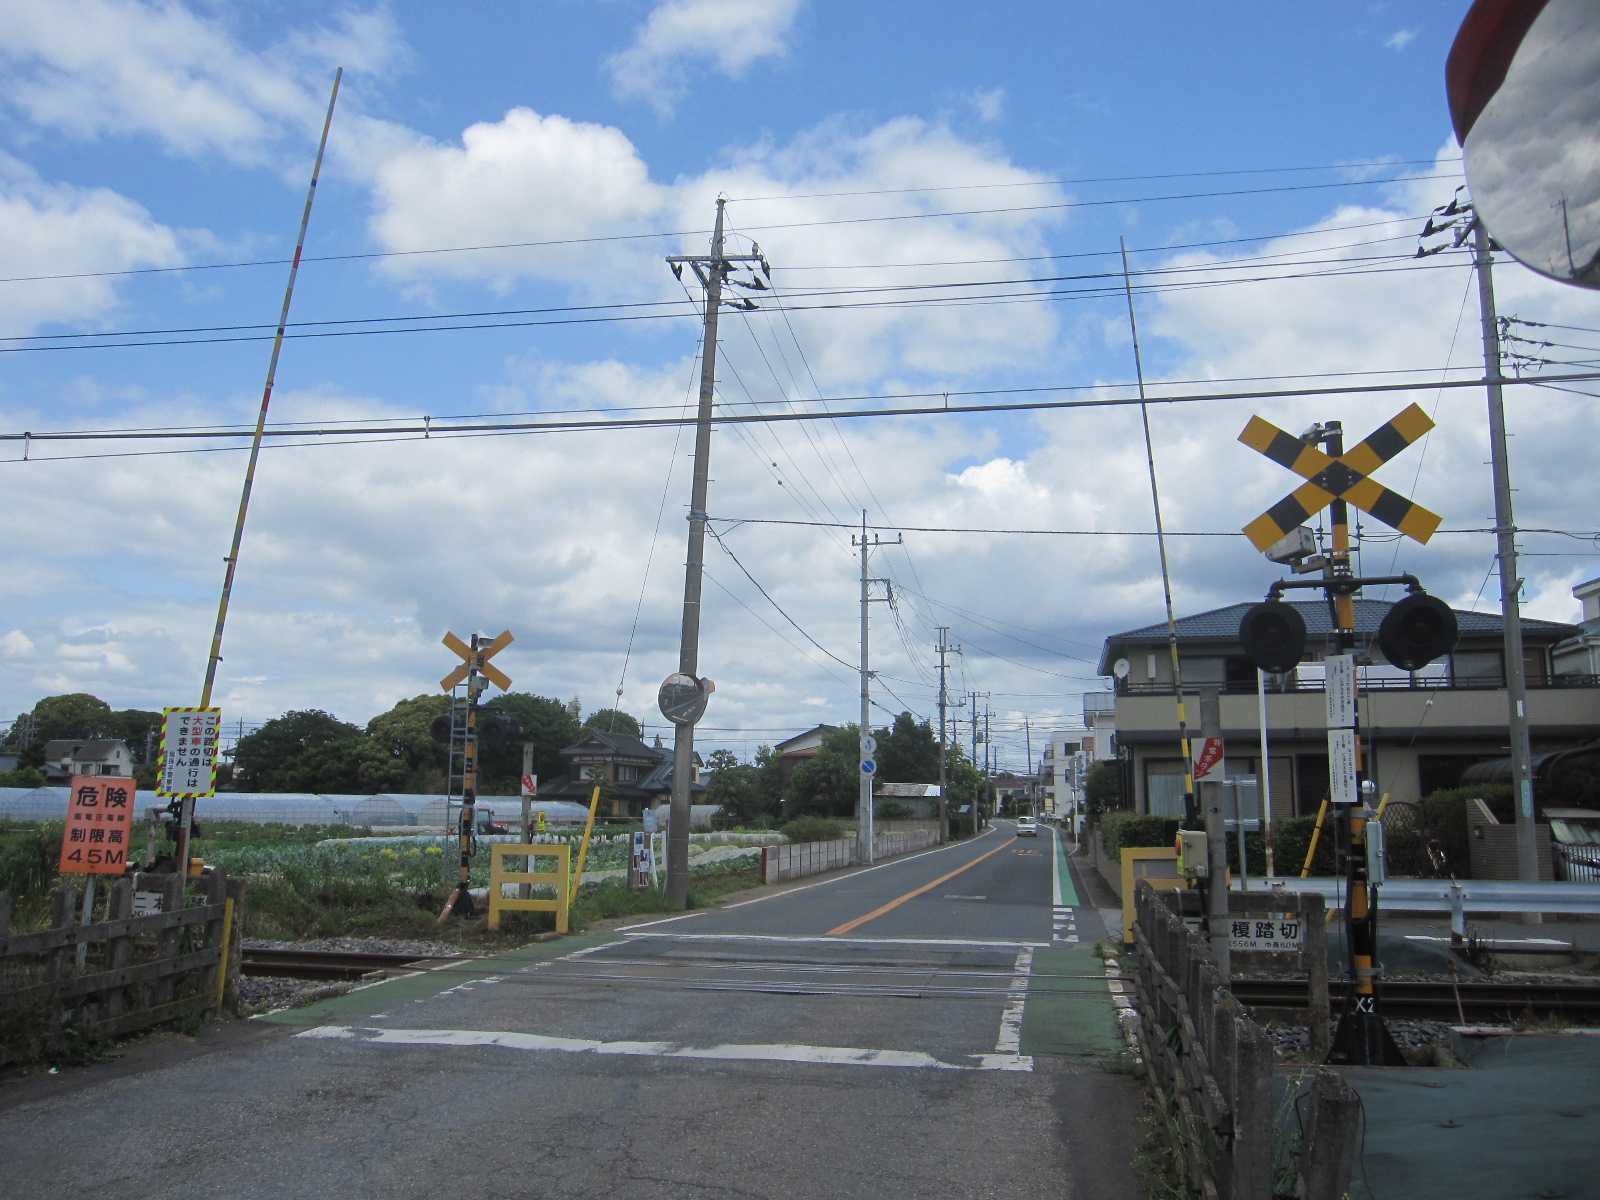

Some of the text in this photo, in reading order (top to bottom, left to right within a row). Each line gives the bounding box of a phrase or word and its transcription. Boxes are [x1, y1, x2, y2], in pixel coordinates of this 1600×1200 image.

[176, 716, 190, 766] できません
[76, 785, 128, 808] 危険
[70, 828, 124, 844] 制限高
